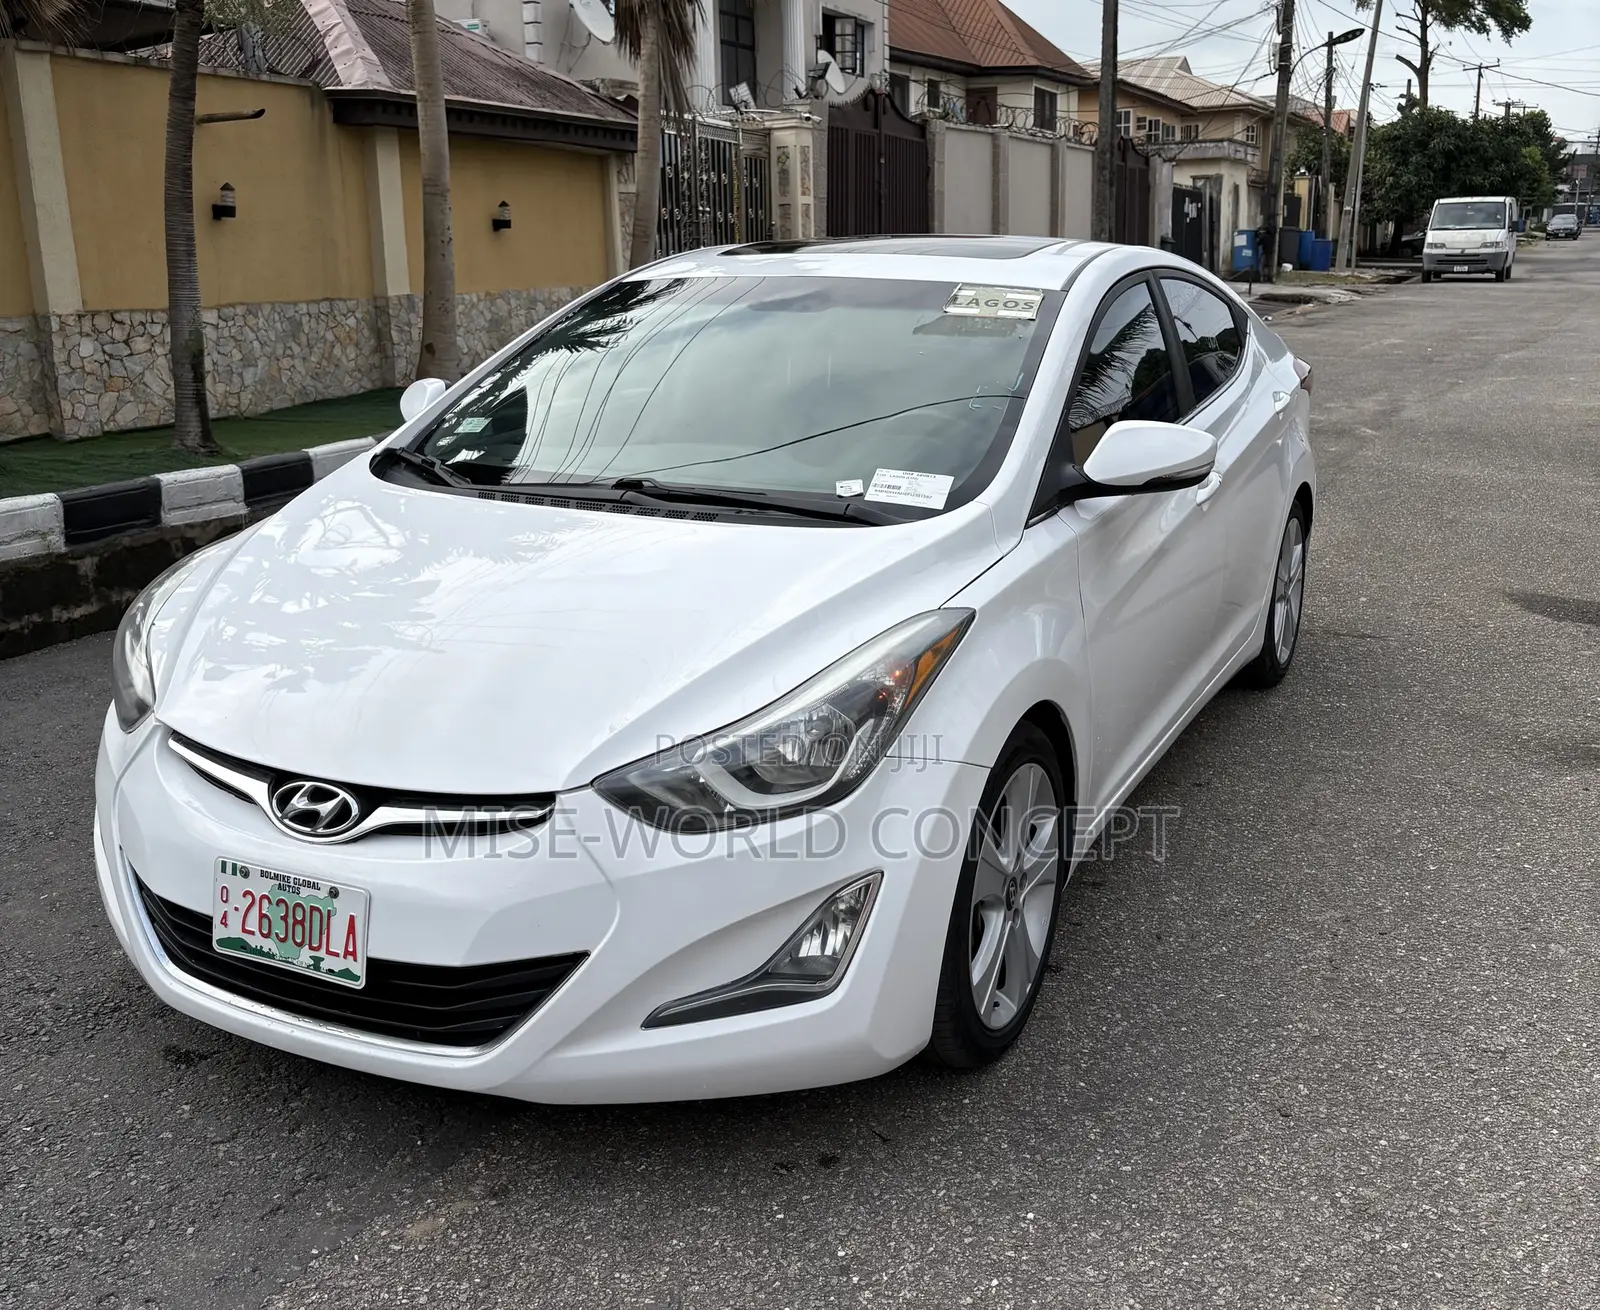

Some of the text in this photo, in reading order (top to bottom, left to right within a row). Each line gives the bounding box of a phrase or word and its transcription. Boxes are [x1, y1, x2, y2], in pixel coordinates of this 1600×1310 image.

[951, 296, 1035, 310] LAGOS
[260, 869, 321, 890] BOLMIKE GLOBAL
[277, 882, 301, 895] AUTOS
